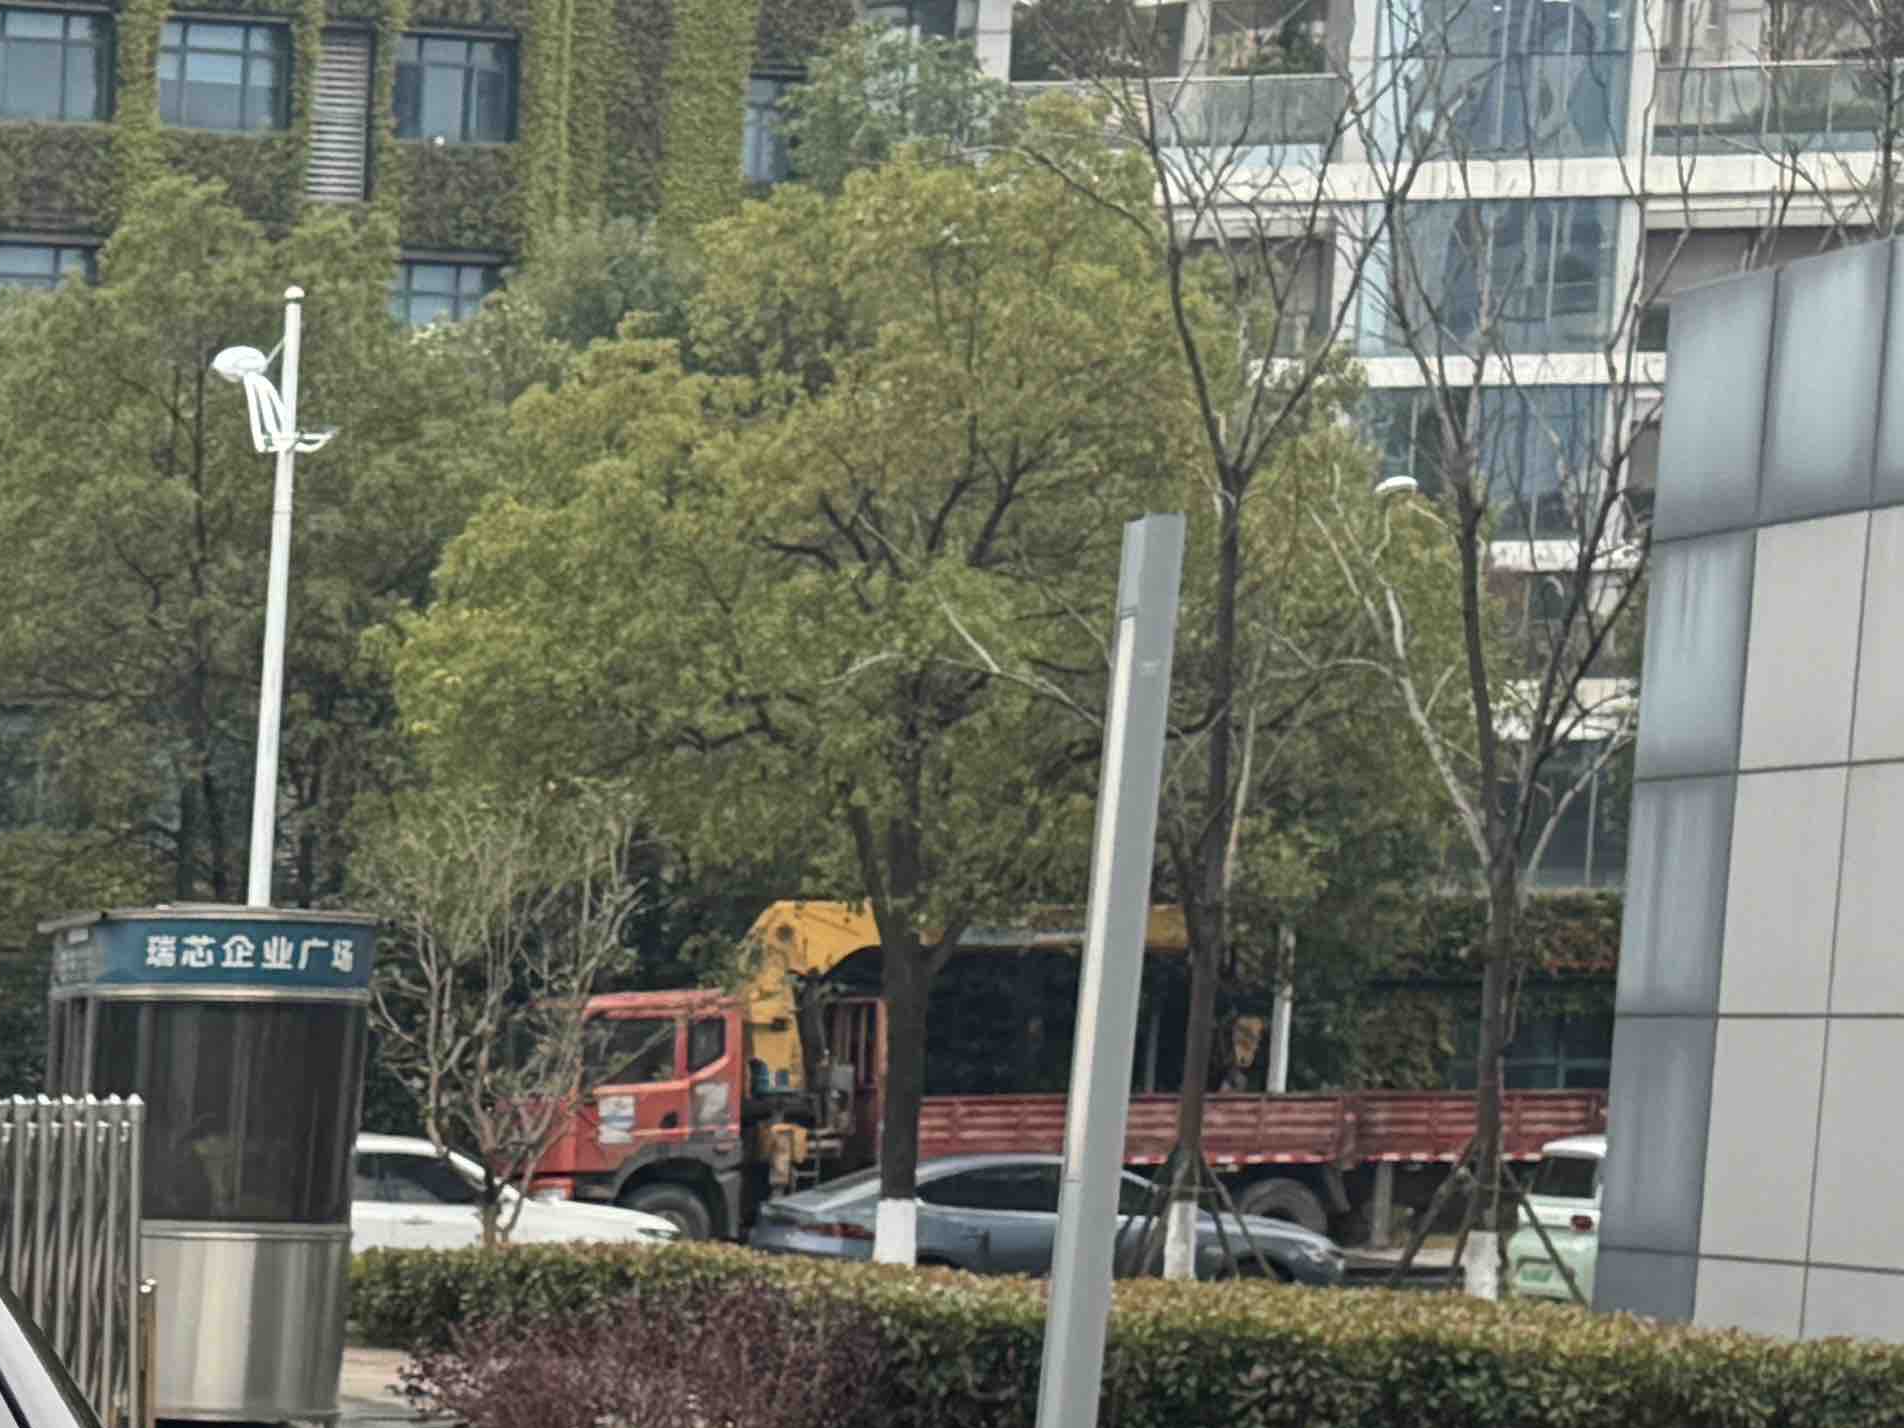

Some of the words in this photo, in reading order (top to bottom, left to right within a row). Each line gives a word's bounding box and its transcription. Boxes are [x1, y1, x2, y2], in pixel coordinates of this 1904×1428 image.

[145, 935, 353, 973] 瑞芯企业广场
